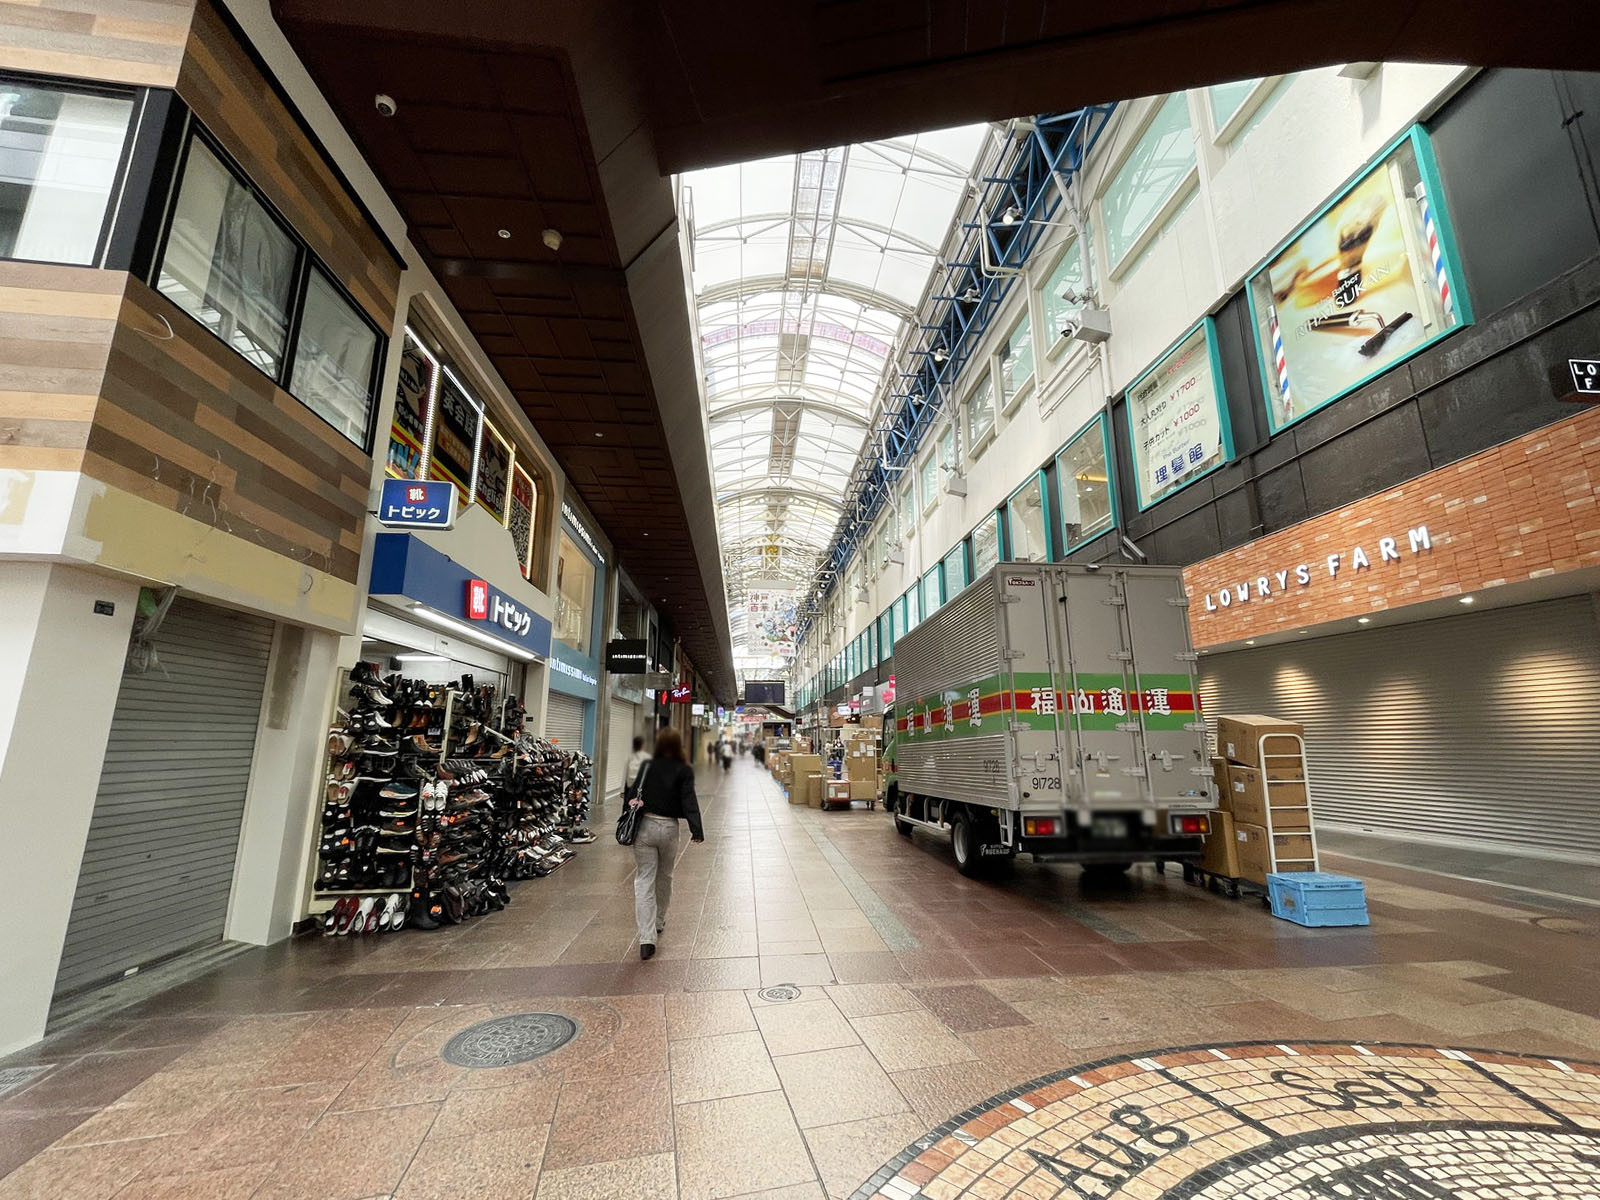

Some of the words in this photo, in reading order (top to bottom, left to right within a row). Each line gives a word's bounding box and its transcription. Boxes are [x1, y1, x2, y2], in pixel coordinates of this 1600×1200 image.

[1332, 273, 1359, 297] Barber
[1169, 377, 1196, 401] ¥1700
[441, 388, 475, 438] 英会話
[1173, 403, 1200, 427] ¥1000
[409, 488, 425, 501] 靴
[388, 505, 440, 520] トピック
[1205, 564, 1311, 612] LOWRYS
[1327, 525, 1433, 577] FARM
[473, 586, 486, 613] 靴
[491, 595, 531, 636] トピック
[1031, 687, 1172, 716] 福山通運
[1032, 777, 1062, 790] 91728
[1270, 1069, 1444, 1111] Sep
[1027, 1104, 1191, 1200] Aug
